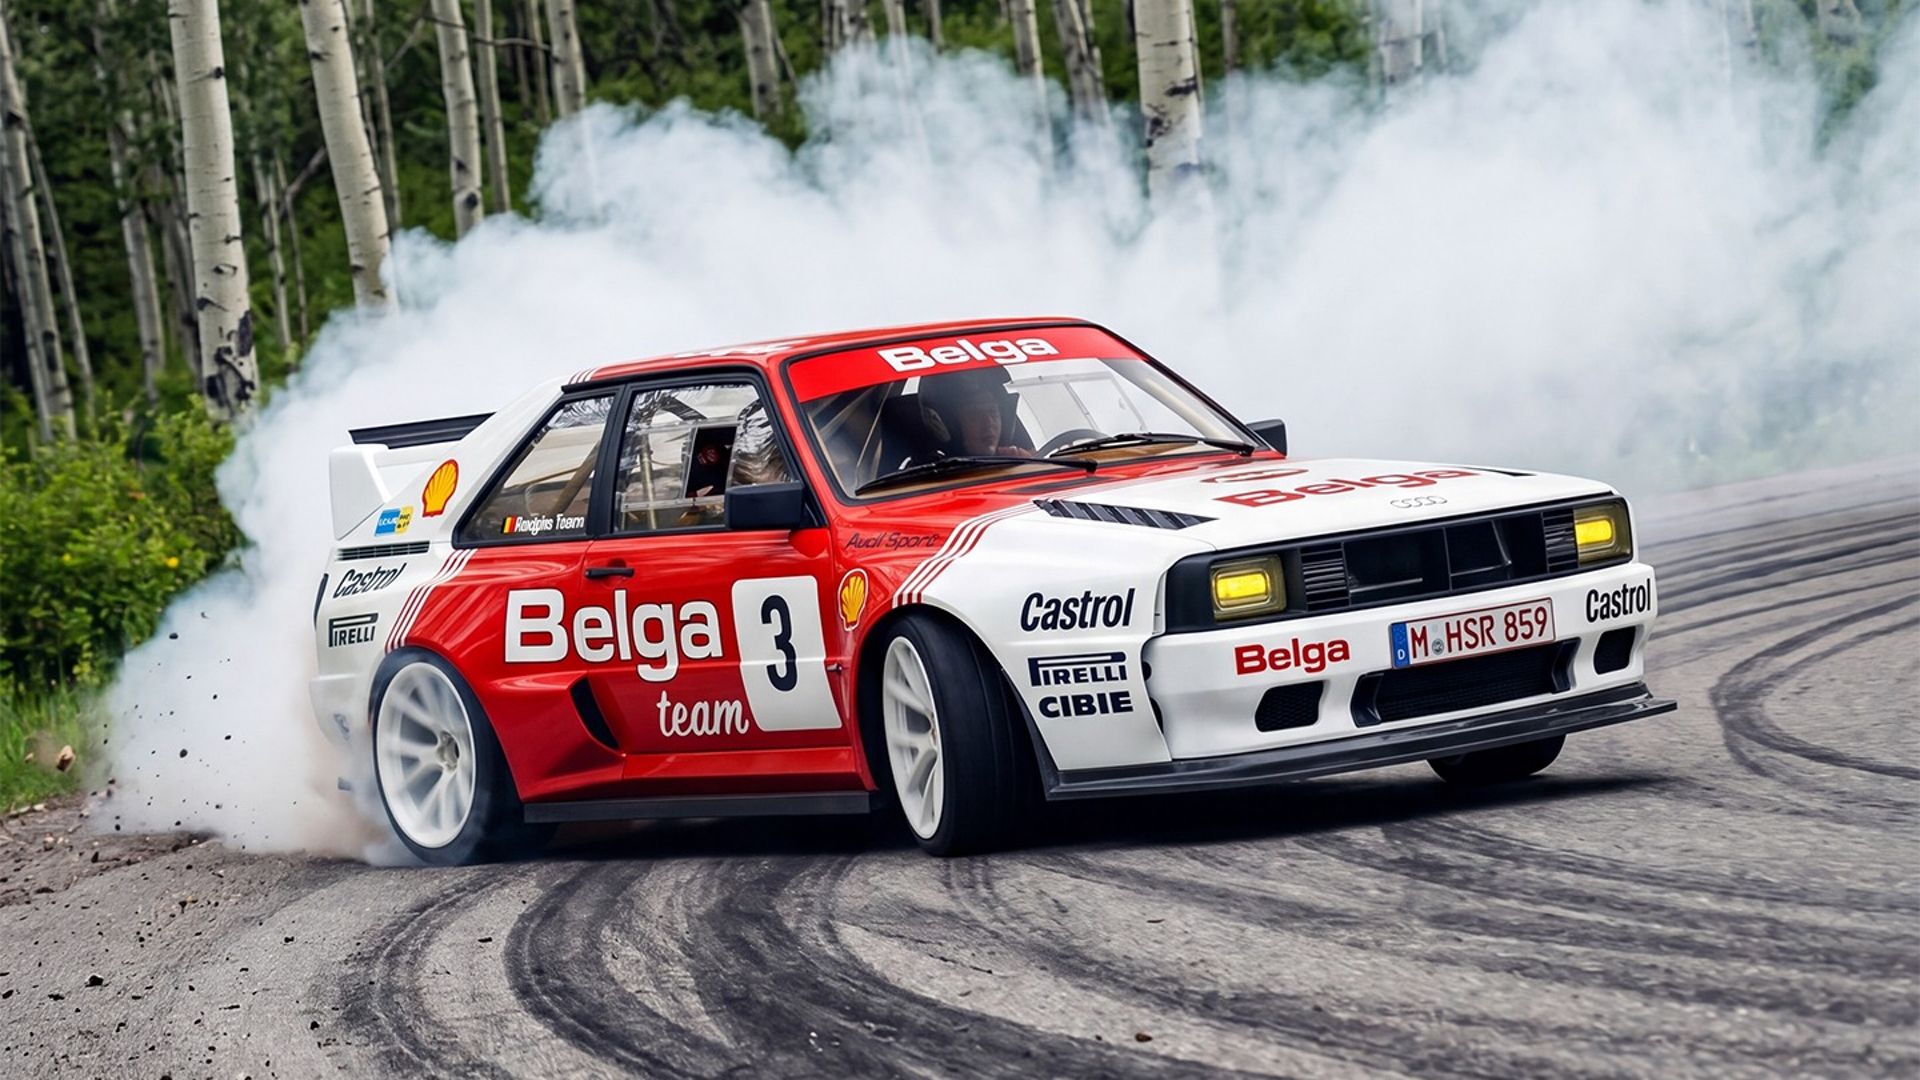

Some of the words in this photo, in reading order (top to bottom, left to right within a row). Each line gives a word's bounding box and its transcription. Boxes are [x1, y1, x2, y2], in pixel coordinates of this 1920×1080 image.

[877, 337, 1059, 373] Belga
[1212, 470, 1481, 508] Belga
[885, 532, 940, 550] Sport
[333, 562, 407, 598] Castrol
[1020, 588, 1135, 631] Castrol
[1586, 578, 1652, 623] Castrol
[328, 612, 379, 648] PIRELLI
[504, 588, 724, 682] Belga
[760, 594, 799, 692] 3
[1410, 625, 1429, 659] M
[1445, 615, 1496, 653] HSR
[1504, 606, 1548, 642] 859
[1027, 651, 1127, 687] PIRELLI
[1234, 638, 1350, 676] Belga
[656, 690, 749, 738] team
[1039, 691, 1133, 718] CIBIE
